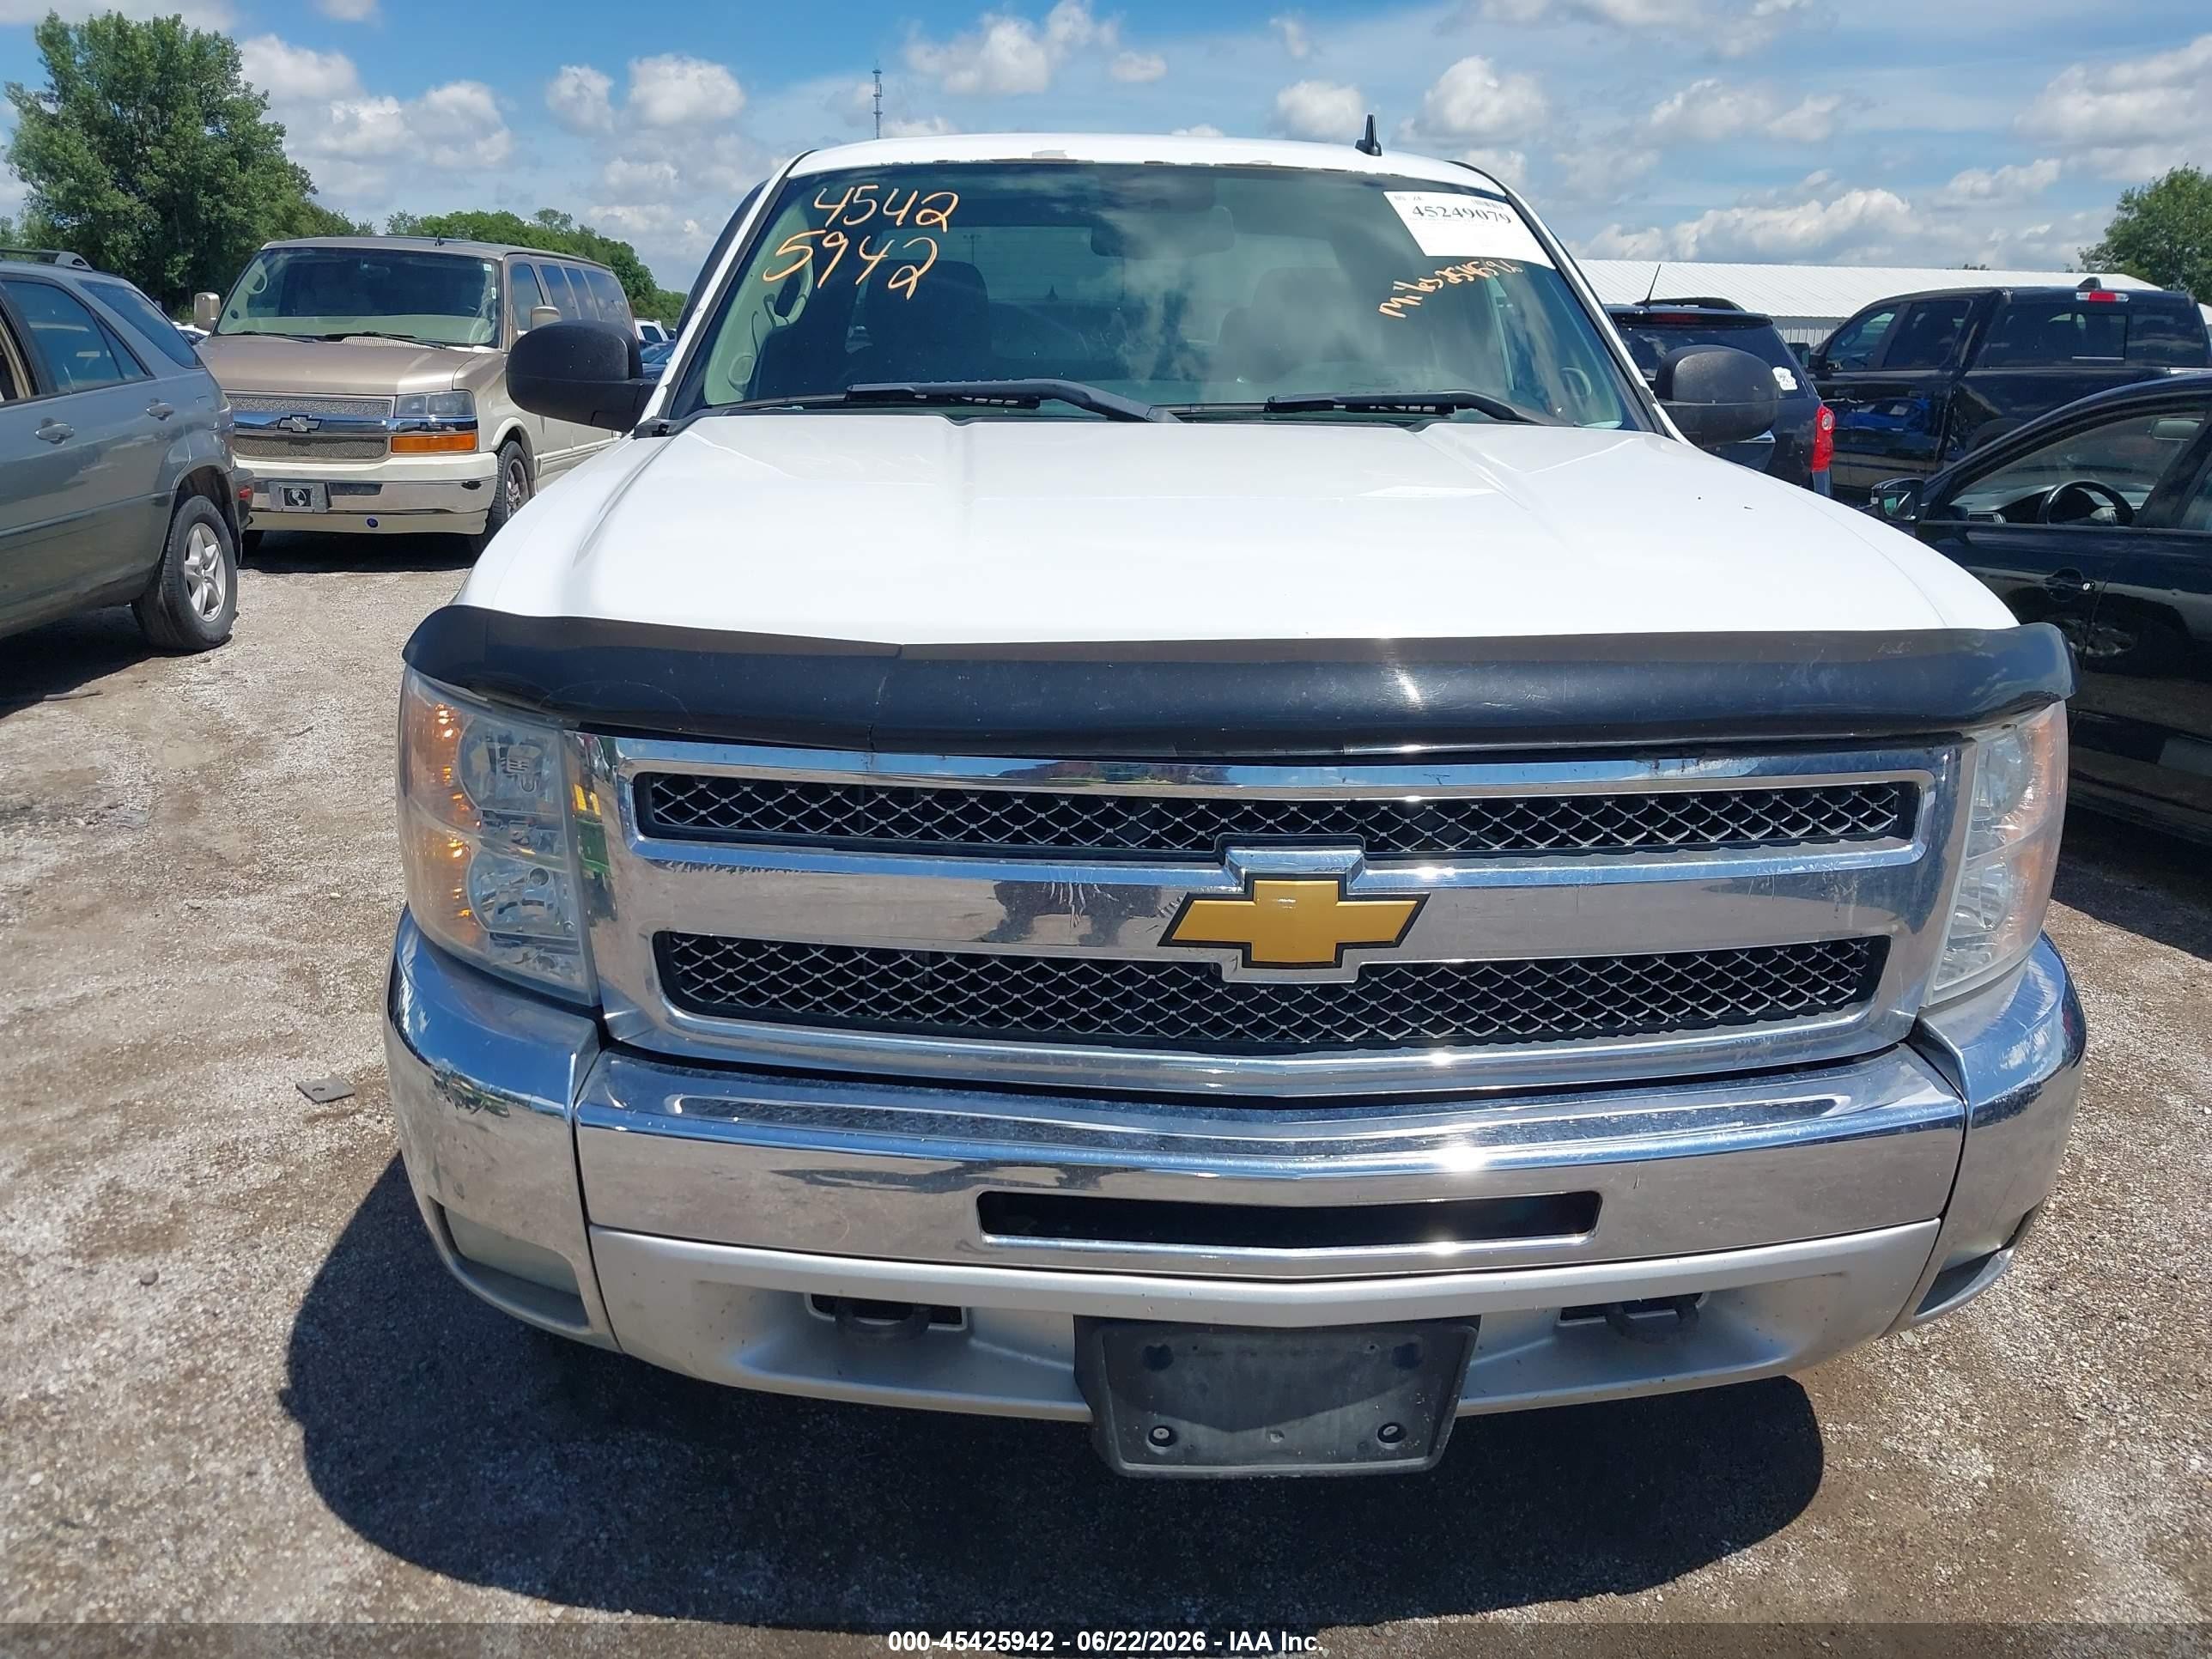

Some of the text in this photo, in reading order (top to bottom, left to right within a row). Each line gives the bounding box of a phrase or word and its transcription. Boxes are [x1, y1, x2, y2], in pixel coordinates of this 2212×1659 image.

[813, 185, 959, 233] 4542
[1412, 205, 1512, 223] 45249079
[762, 229, 939, 301] 5942
